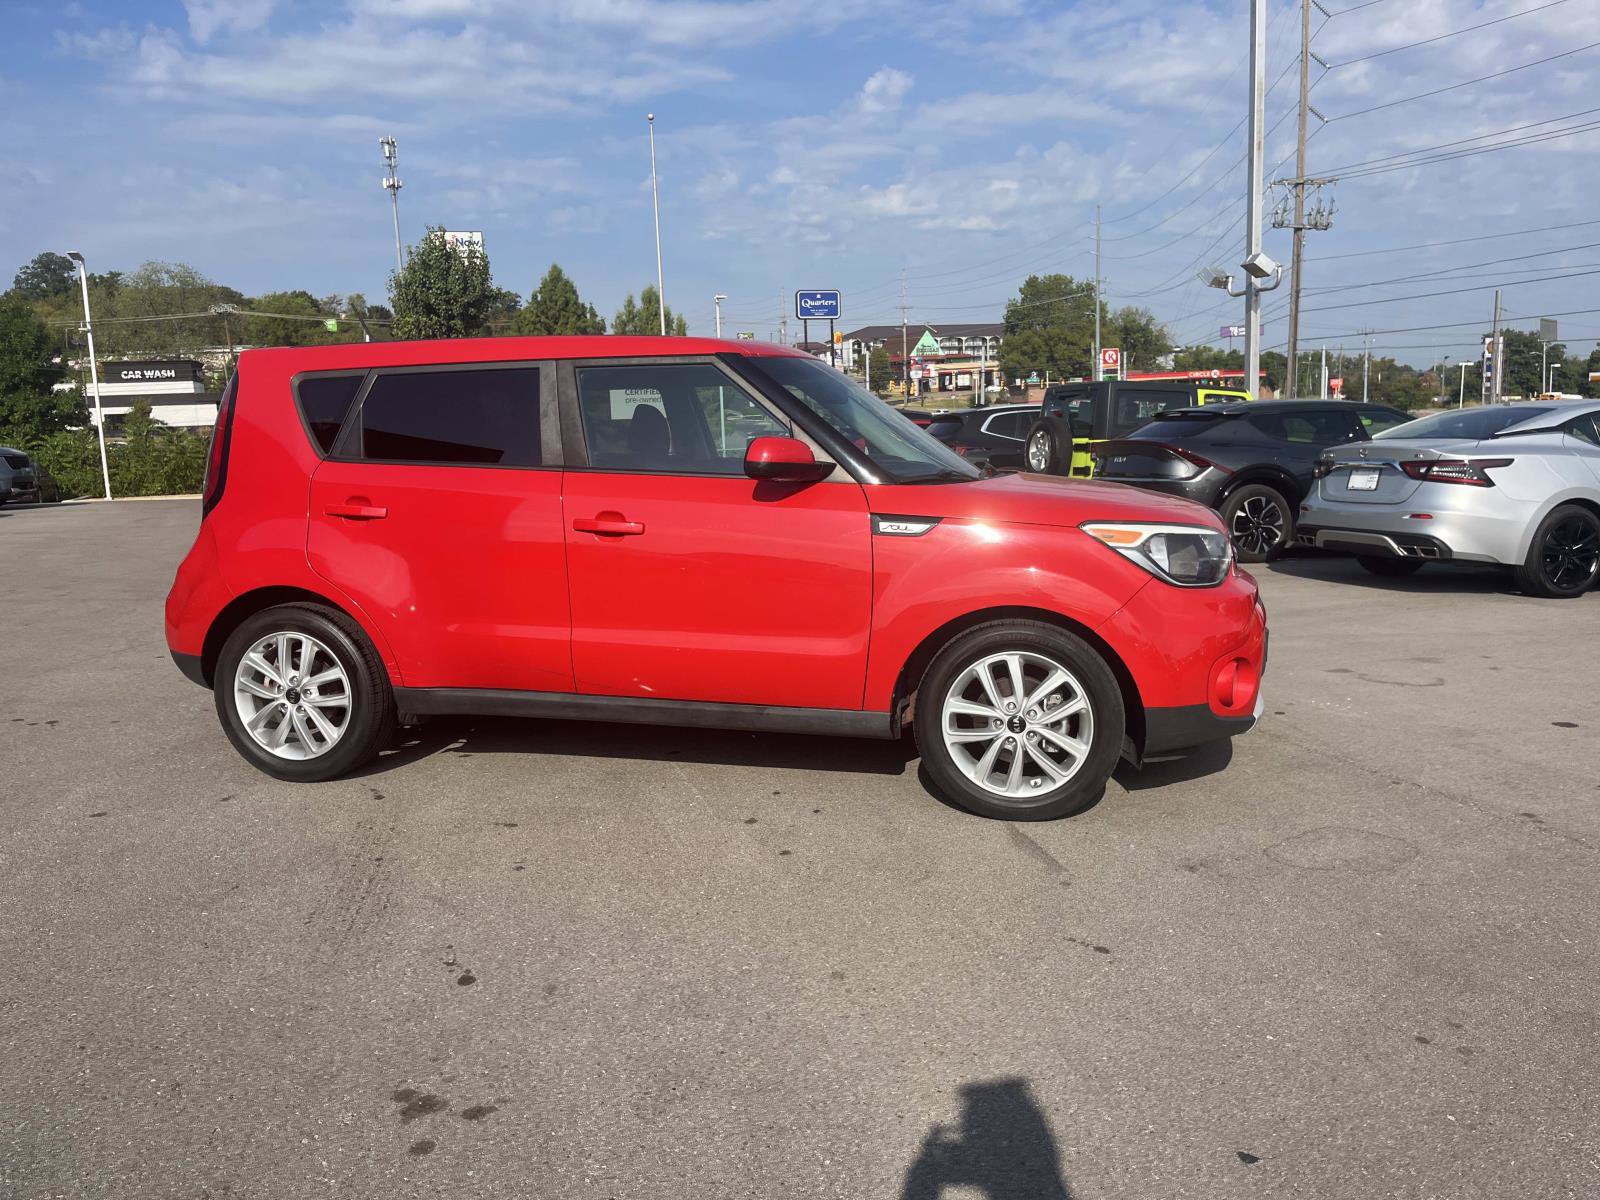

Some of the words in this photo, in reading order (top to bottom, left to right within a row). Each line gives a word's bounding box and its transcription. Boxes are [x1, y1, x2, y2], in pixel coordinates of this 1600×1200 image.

[801, 298, 836, 308] Quarters
[121, 371, 142, 379] CAR
[144, 370, 176, 378] WASH
[625, 397, 662, 405] pre-owned
